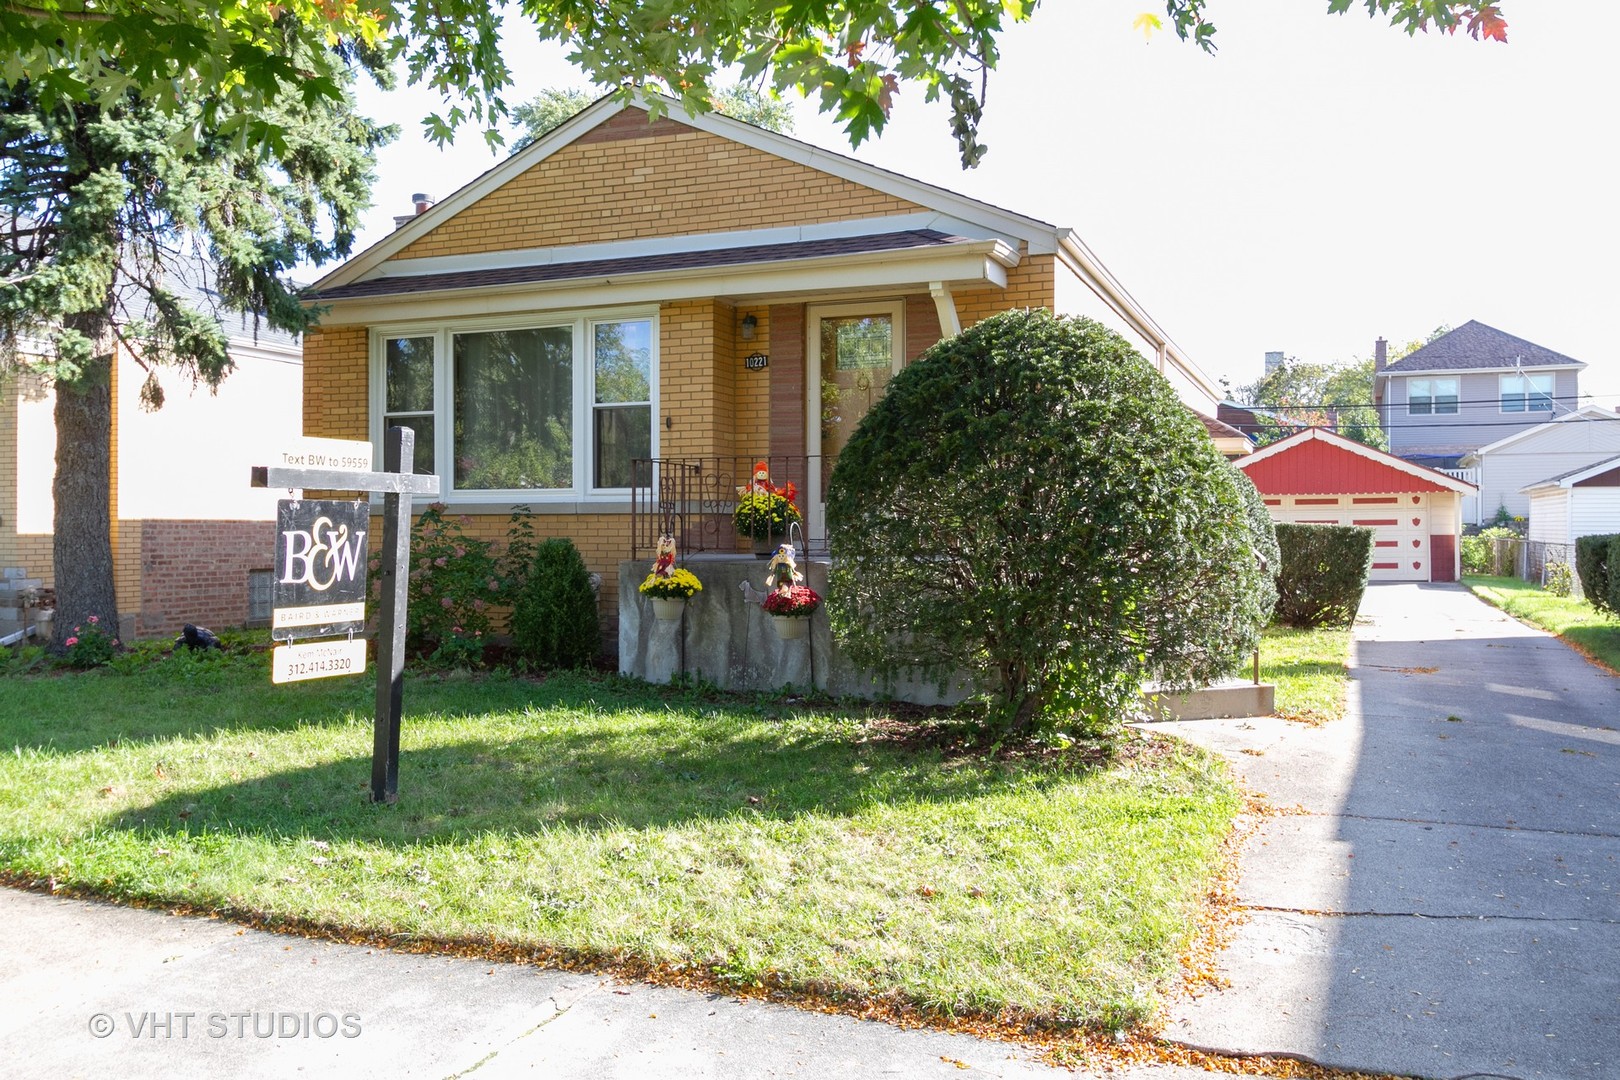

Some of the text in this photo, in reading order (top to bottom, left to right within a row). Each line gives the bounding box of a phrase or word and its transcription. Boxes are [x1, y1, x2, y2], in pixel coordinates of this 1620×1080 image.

[745, 356, 767, 368] 10221
[282, 452, 369, 469] Text BW to 59559
[280, 516, 366, 591] B&W
[280, 611, 312, 622] BAIRD
[288, 658, 351, 676] 312.414.3320
